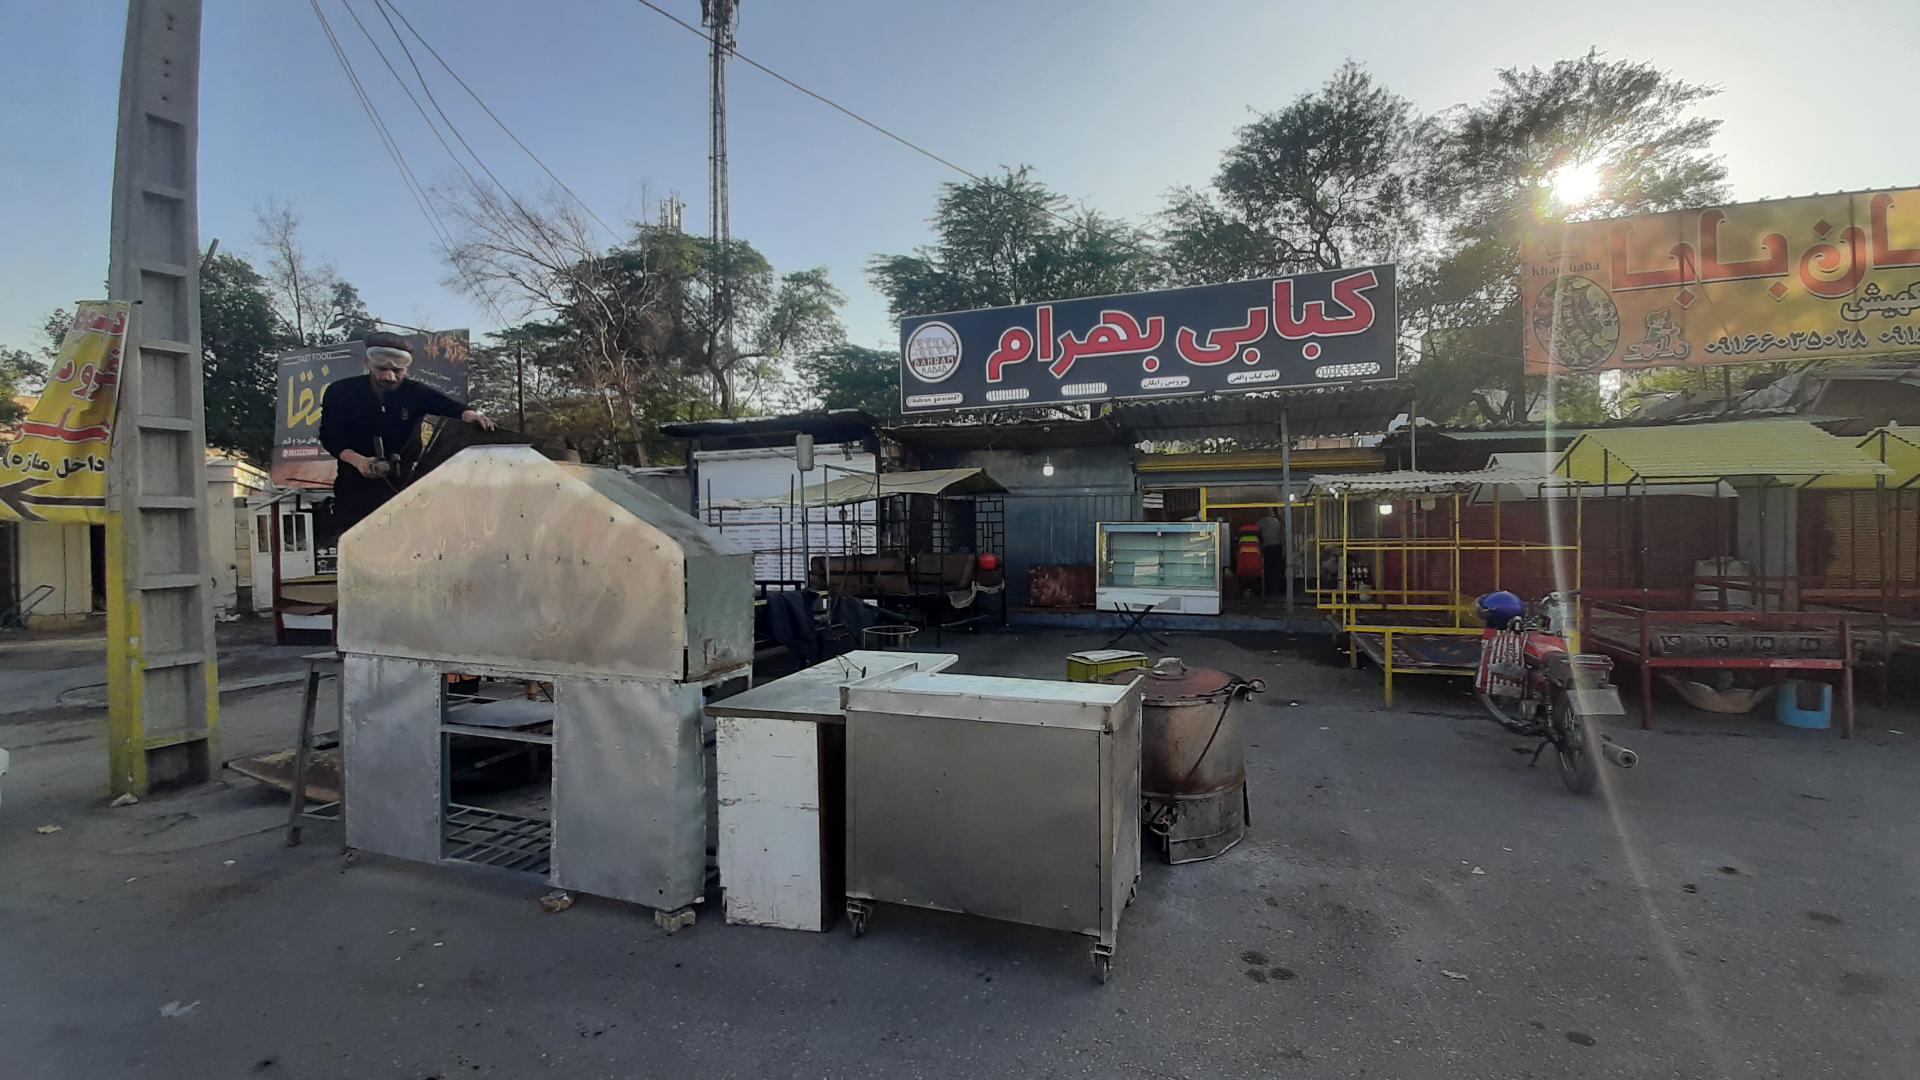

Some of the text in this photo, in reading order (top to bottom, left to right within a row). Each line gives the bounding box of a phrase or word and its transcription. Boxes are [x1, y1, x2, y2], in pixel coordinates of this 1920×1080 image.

[1610, 208, 1788, 309] بابا
[985, 269, 1379, 383] کبابی بهرام
[915, 356, 954, 367] BAHRAM
[56, 453, 105, 479] داخل
